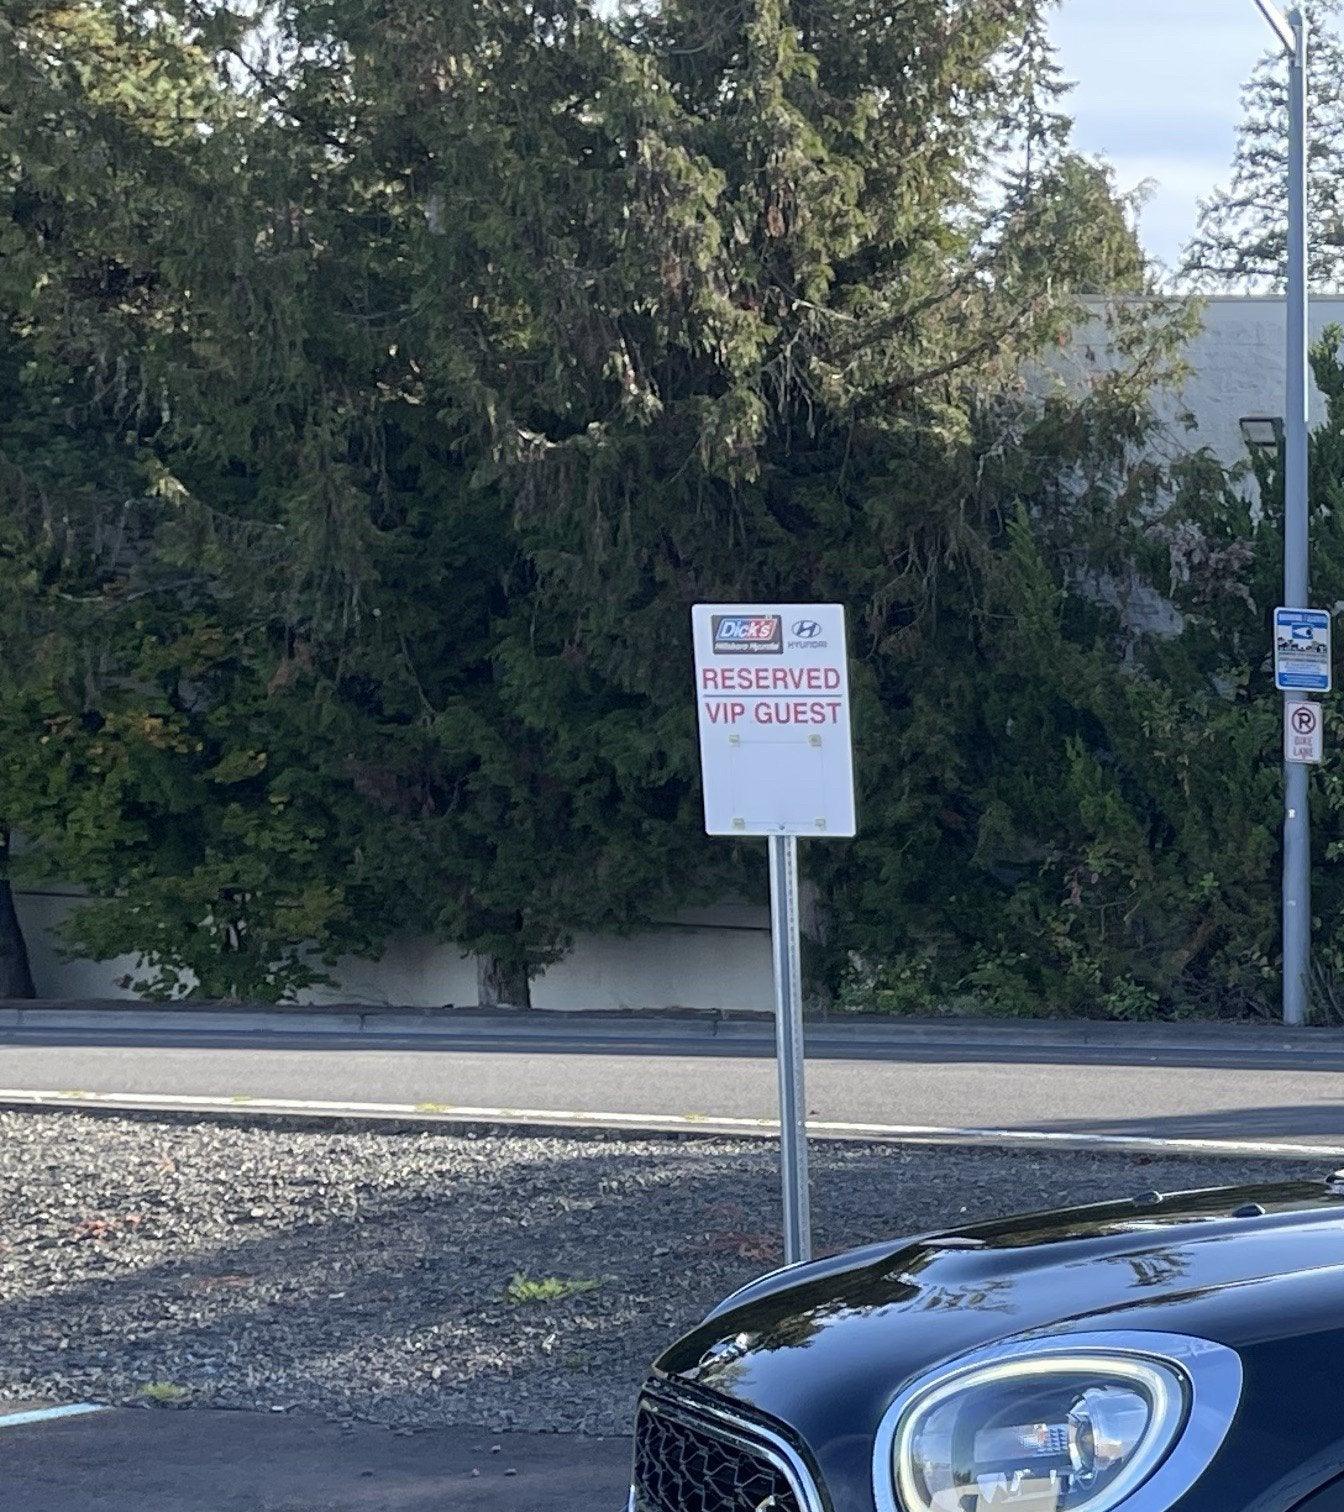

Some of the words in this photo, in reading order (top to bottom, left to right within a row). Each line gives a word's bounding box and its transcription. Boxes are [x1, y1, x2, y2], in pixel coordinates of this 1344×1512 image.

[703, 668, 840, 690] RESERVED
[705, 702, 745, 724] VIP
[754, 702, 841, 724] GUEST
